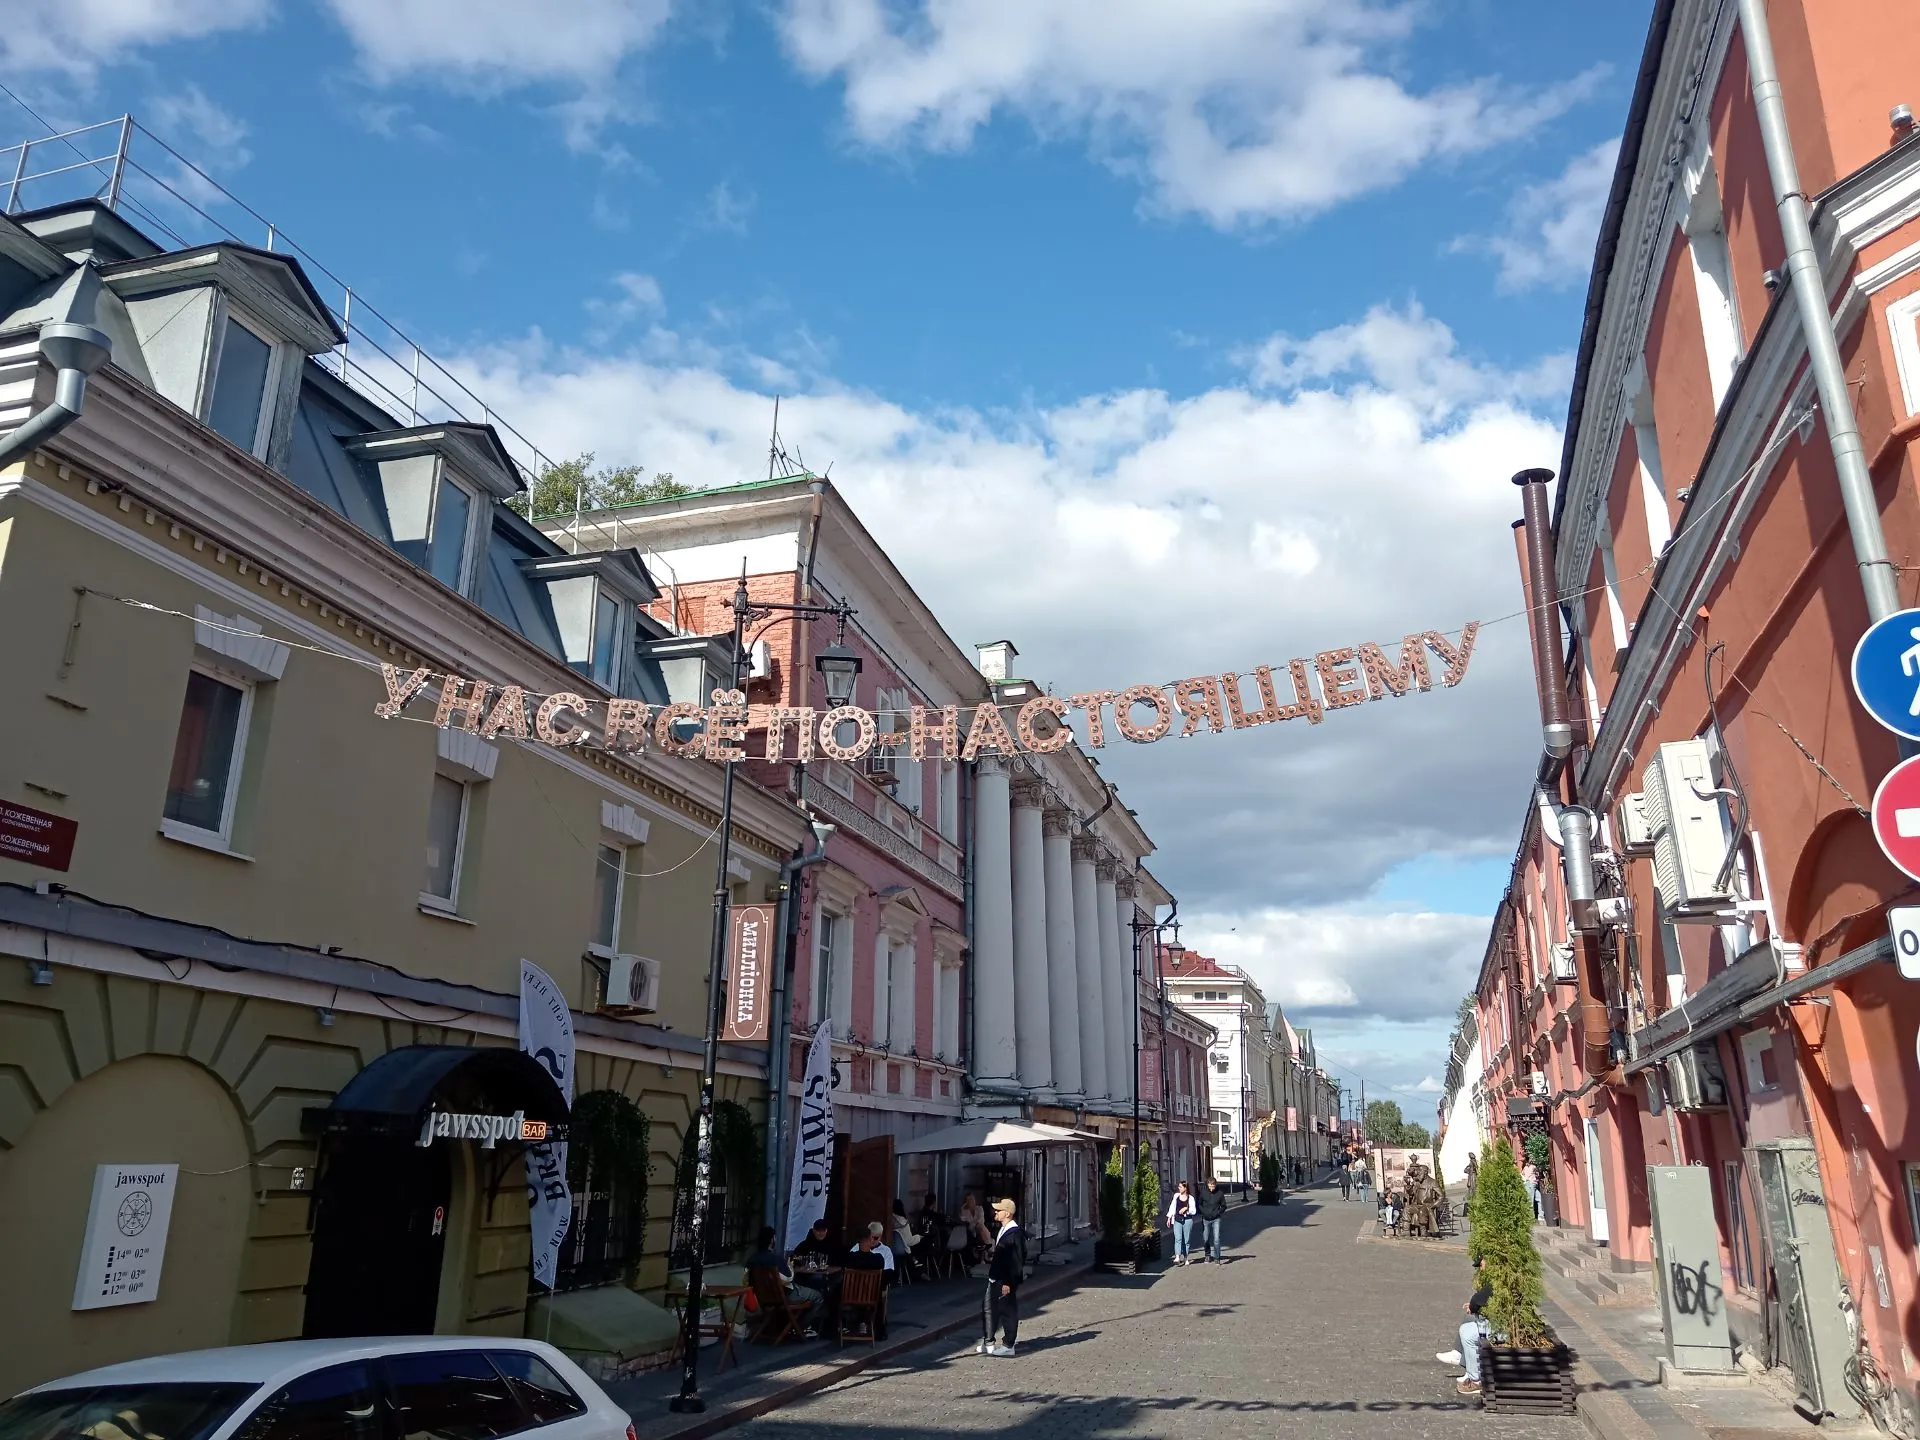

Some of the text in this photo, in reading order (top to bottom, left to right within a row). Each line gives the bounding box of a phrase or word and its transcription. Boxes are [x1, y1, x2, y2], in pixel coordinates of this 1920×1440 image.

[374, 620, 1480, 764] У НАС ВСЁ ПО-НАСТОЯЩЕМУ
[4, 809, 53, 829] КОЖЕВЕННАЯ
[0, 834, 50, 853] КОЖЕВЕННЫЙ
[415, 1101, 546, 1149] jawsspot BAR
[799, 1075, 825, 1197] JAWS
[115, 1172, 166, 1188] jawsspot
[549, 1216, 569, 1248] NOW
